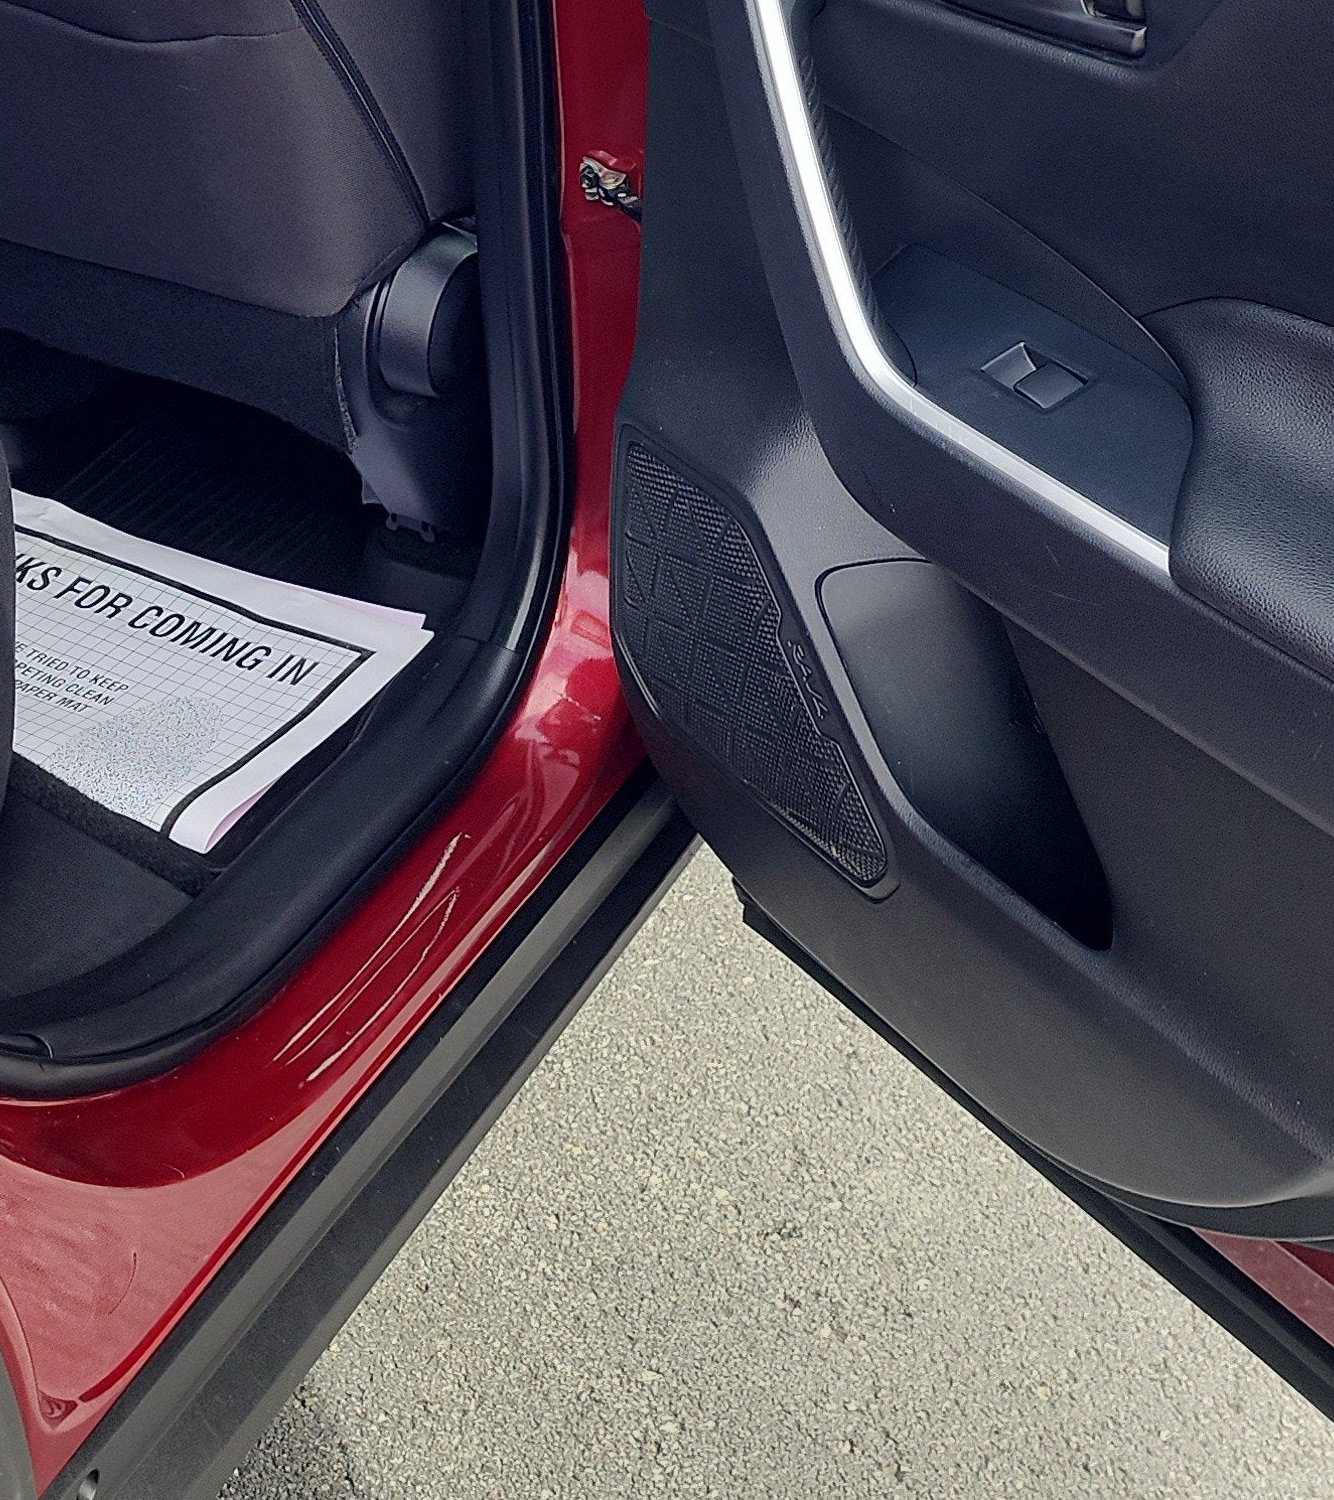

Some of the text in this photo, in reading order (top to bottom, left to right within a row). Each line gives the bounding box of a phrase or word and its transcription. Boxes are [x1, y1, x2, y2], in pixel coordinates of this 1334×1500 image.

[53, 576, 134, 619] FOR
[128, 605, 274, 671] COMING
[267, 652, 321, 687] IN
[15, 659, 115, 706] PETING CLEAN
[26, 648, 70, 672] TRIED
[69, 665, 91, 680] TO
[90, 674, 130, 693] KEEP
[56, 696, 91, 713] MAT
